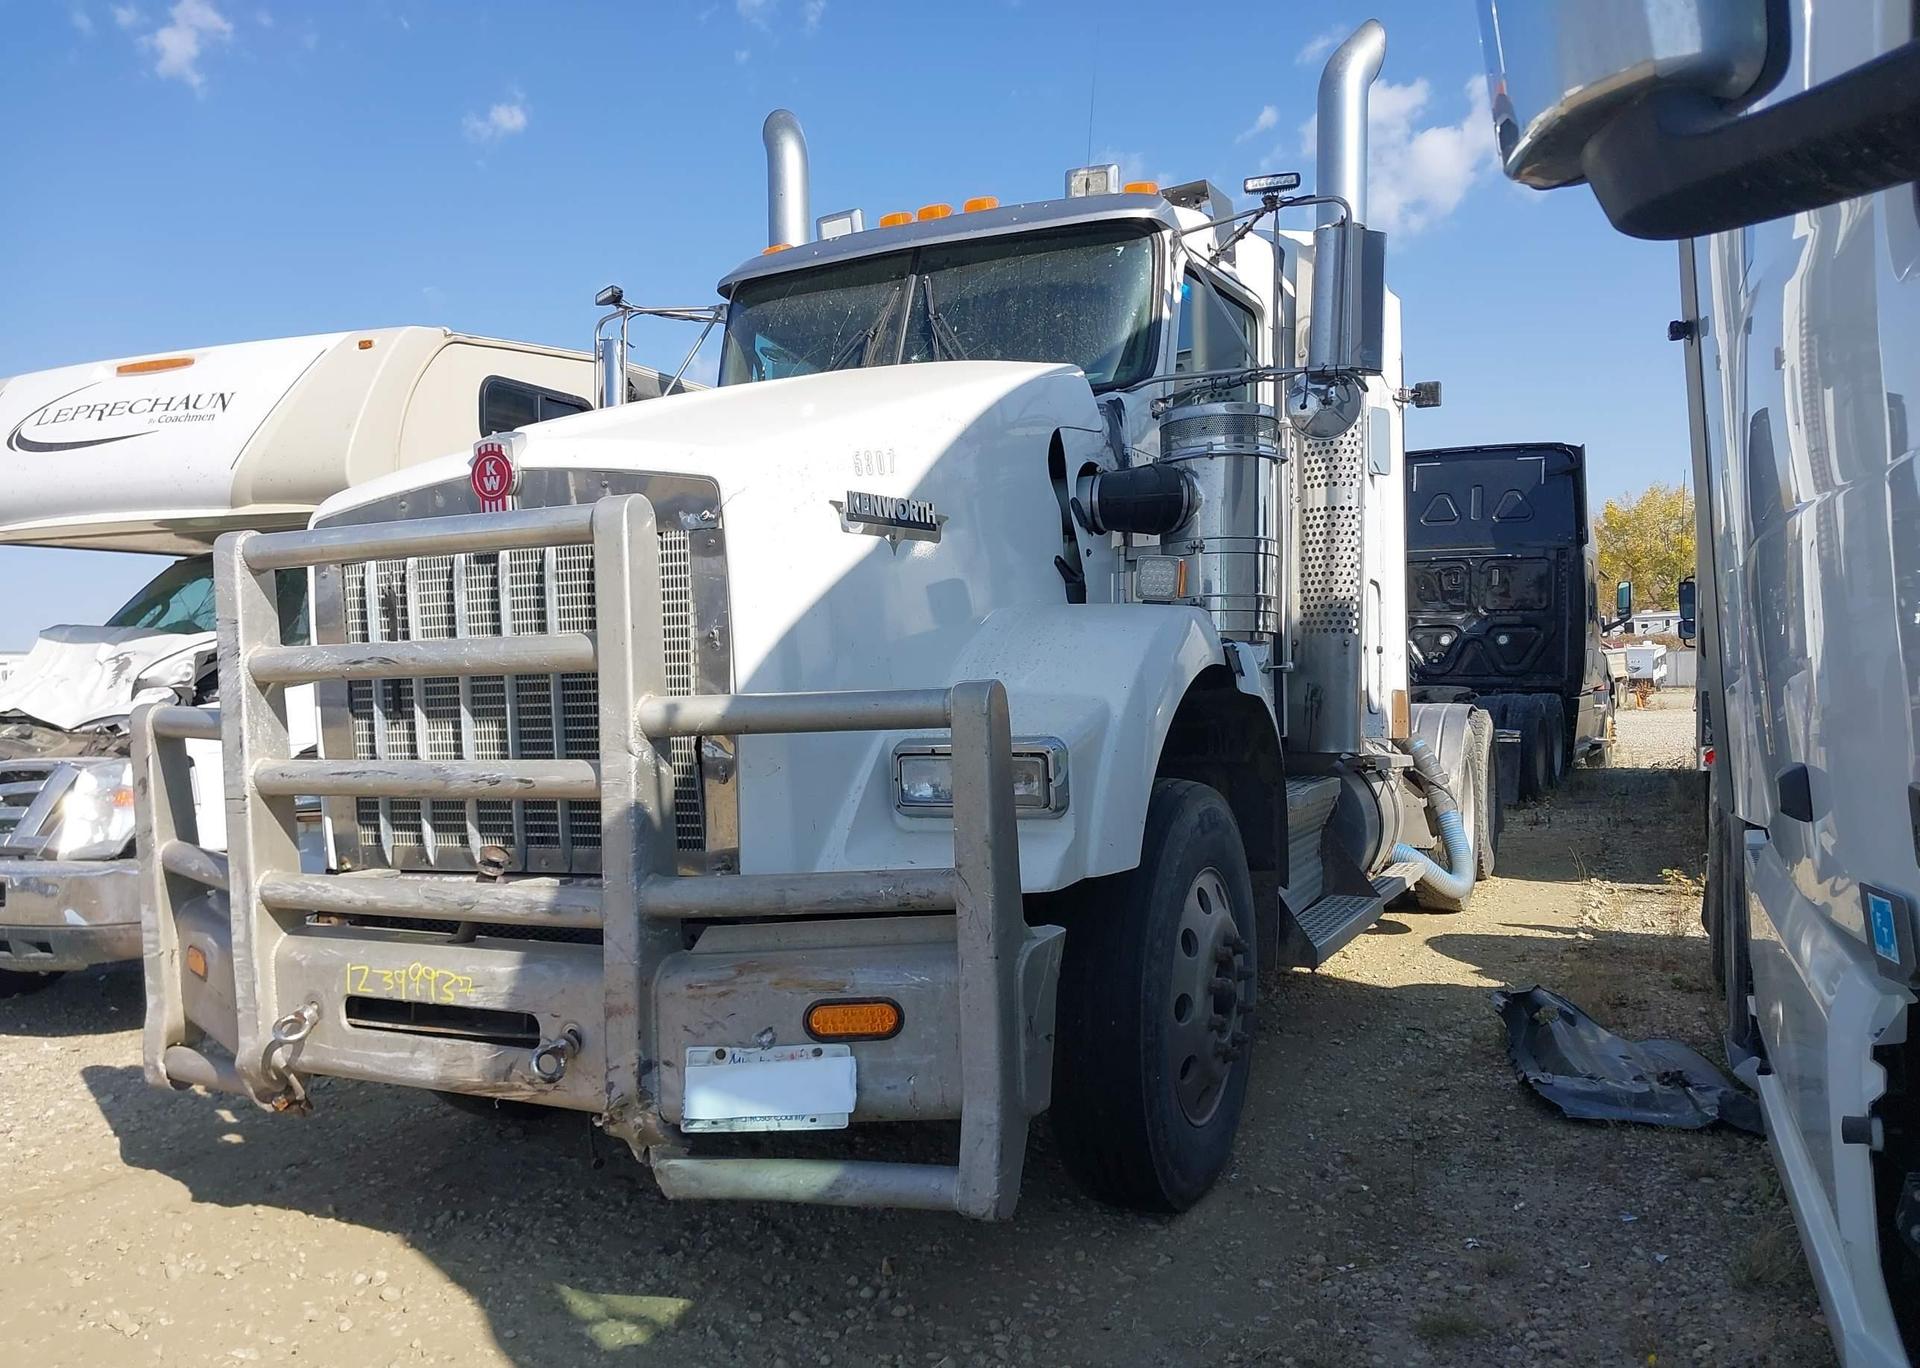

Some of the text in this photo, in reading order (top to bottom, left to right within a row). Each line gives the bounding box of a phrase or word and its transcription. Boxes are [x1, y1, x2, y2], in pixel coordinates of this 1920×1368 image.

[34, 391, 237, 428] LEPRECHAUN
[157, 412, 216, 424] Coachmen
[846, 490, 937, 524] KENWORTH
